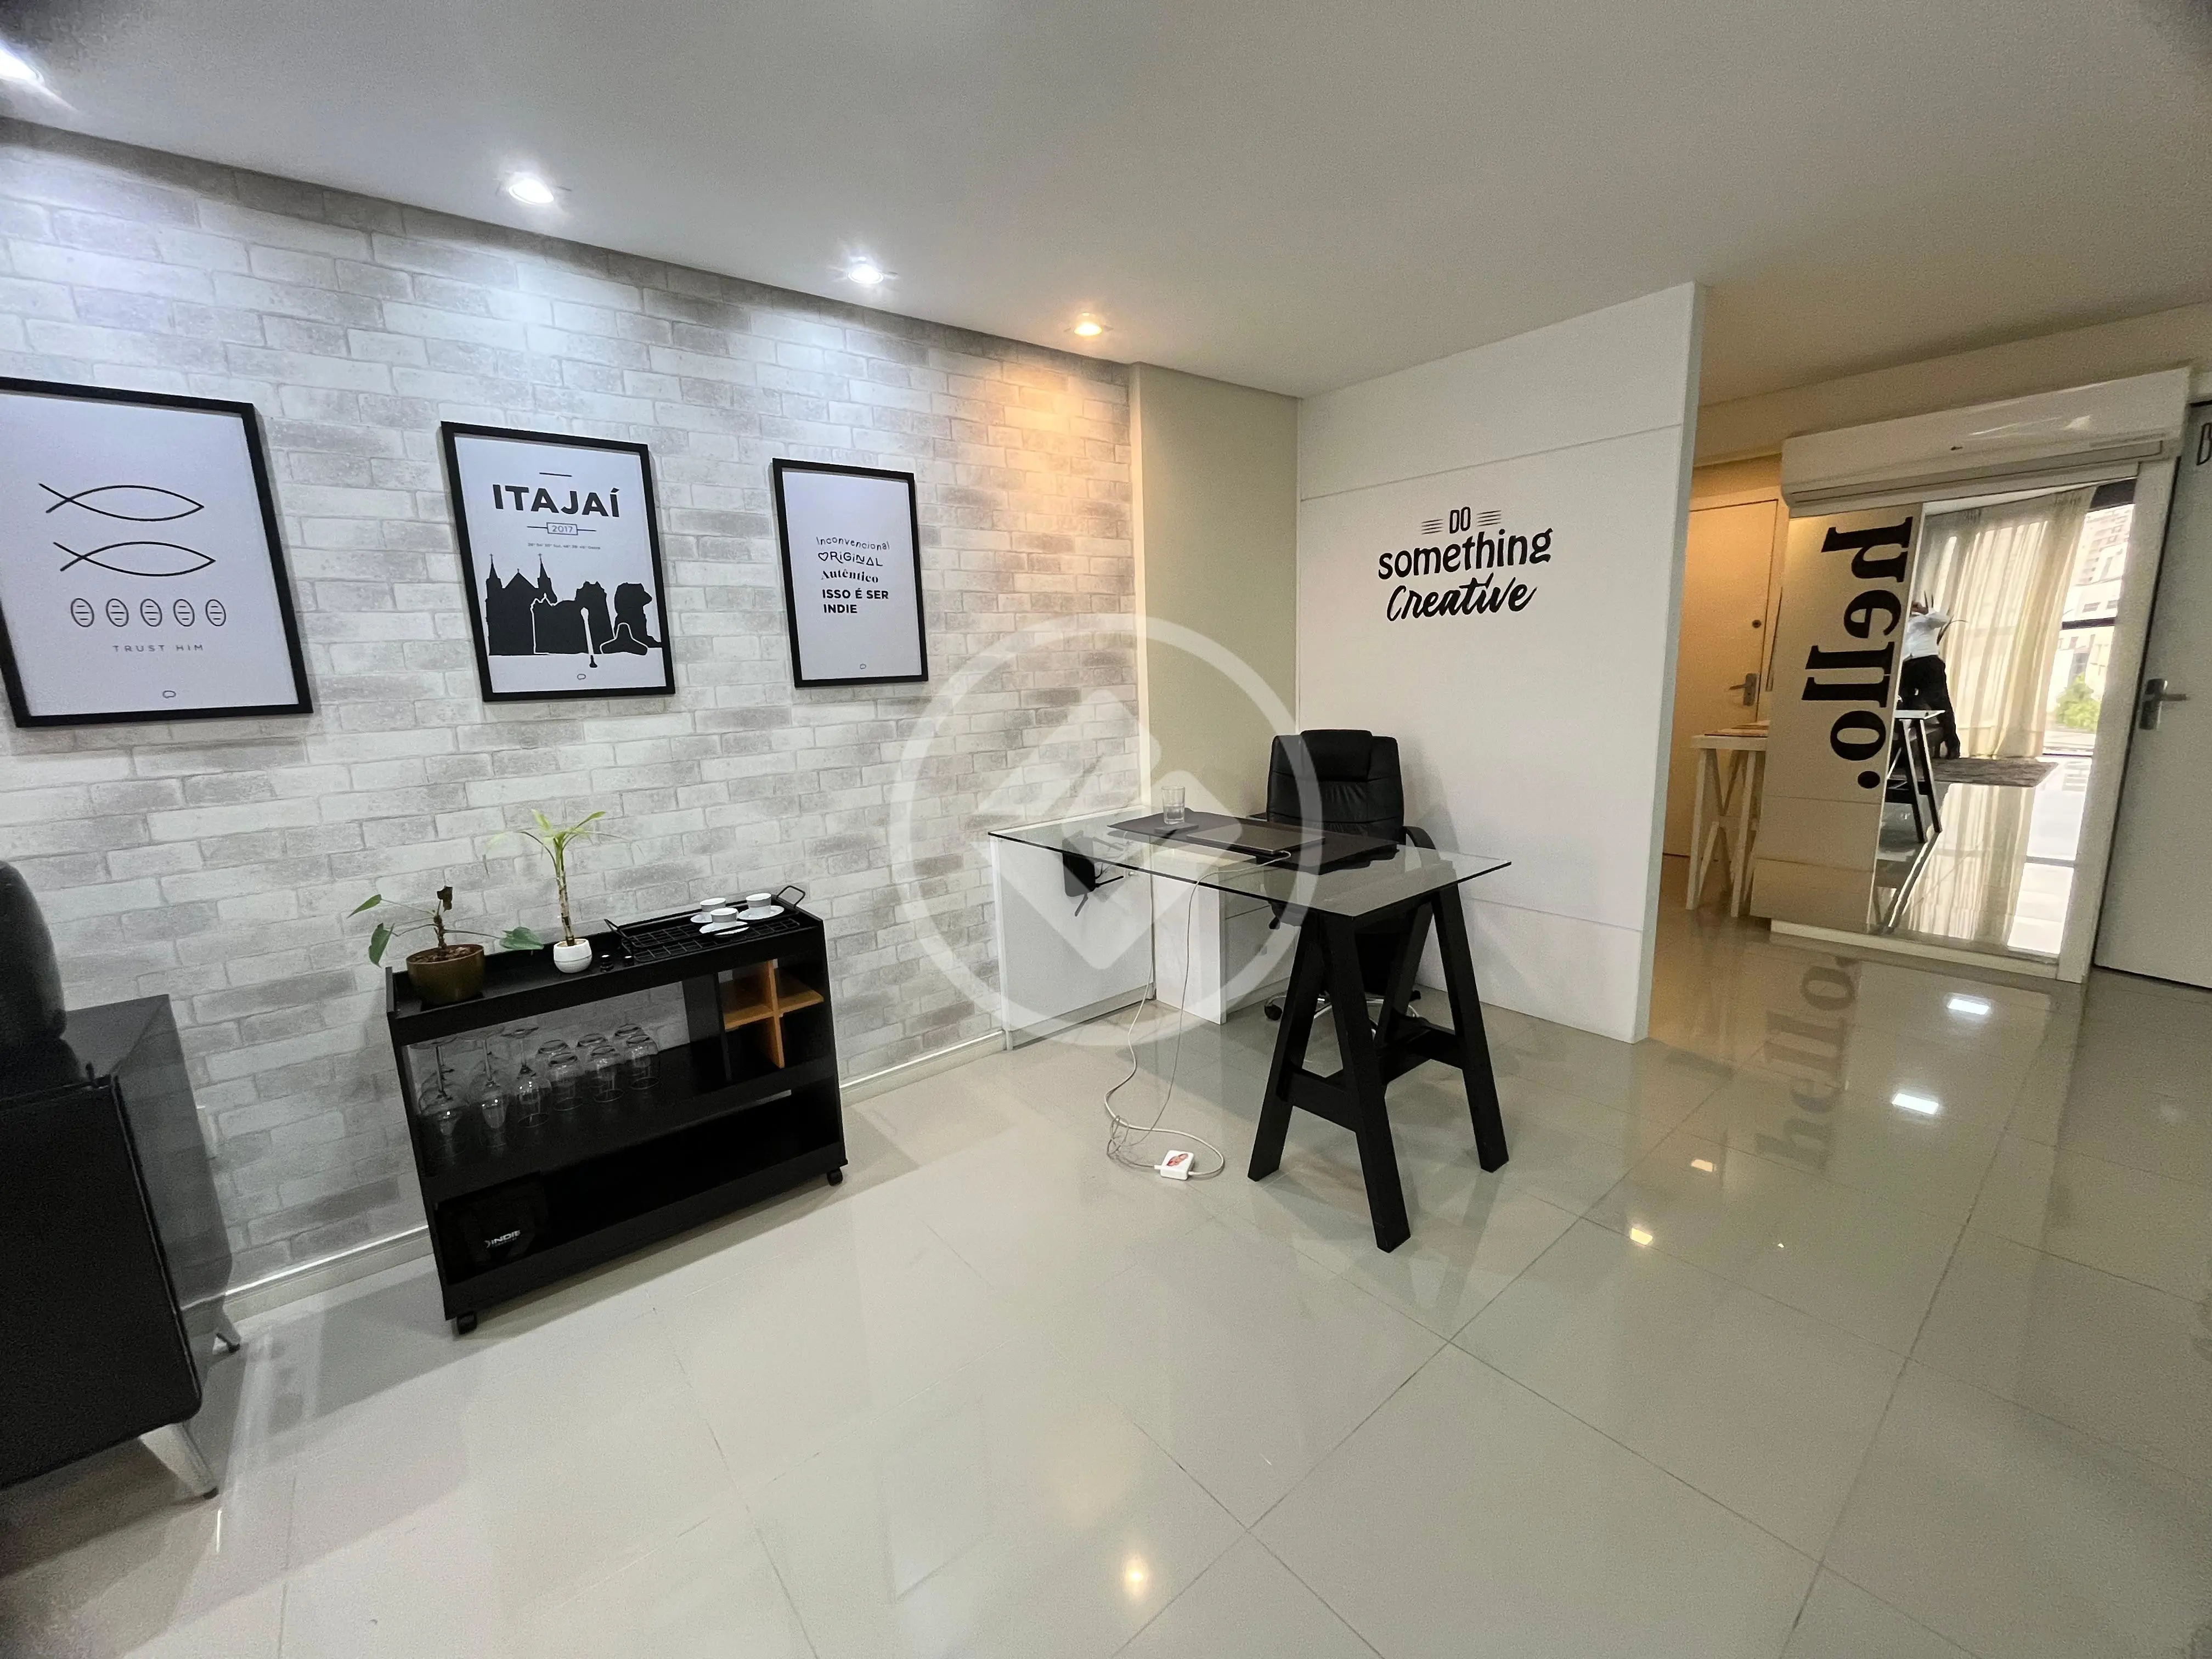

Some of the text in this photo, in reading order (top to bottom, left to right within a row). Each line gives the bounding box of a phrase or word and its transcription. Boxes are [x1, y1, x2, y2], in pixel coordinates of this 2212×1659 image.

[493, 484, 620, 517] ITAJAÍ
[1449, 506, 1471, 534] DO
[816, 536, 890, 551] Inconvencional
[1378, 528, 1553, 580] something
[821, 568, 879, 583] Autêntico
[822, 588, 889, 599] ISSO É SER
[1386, 572, 1538, 622] Creative
[823, 604, 857, 613] INDIE
